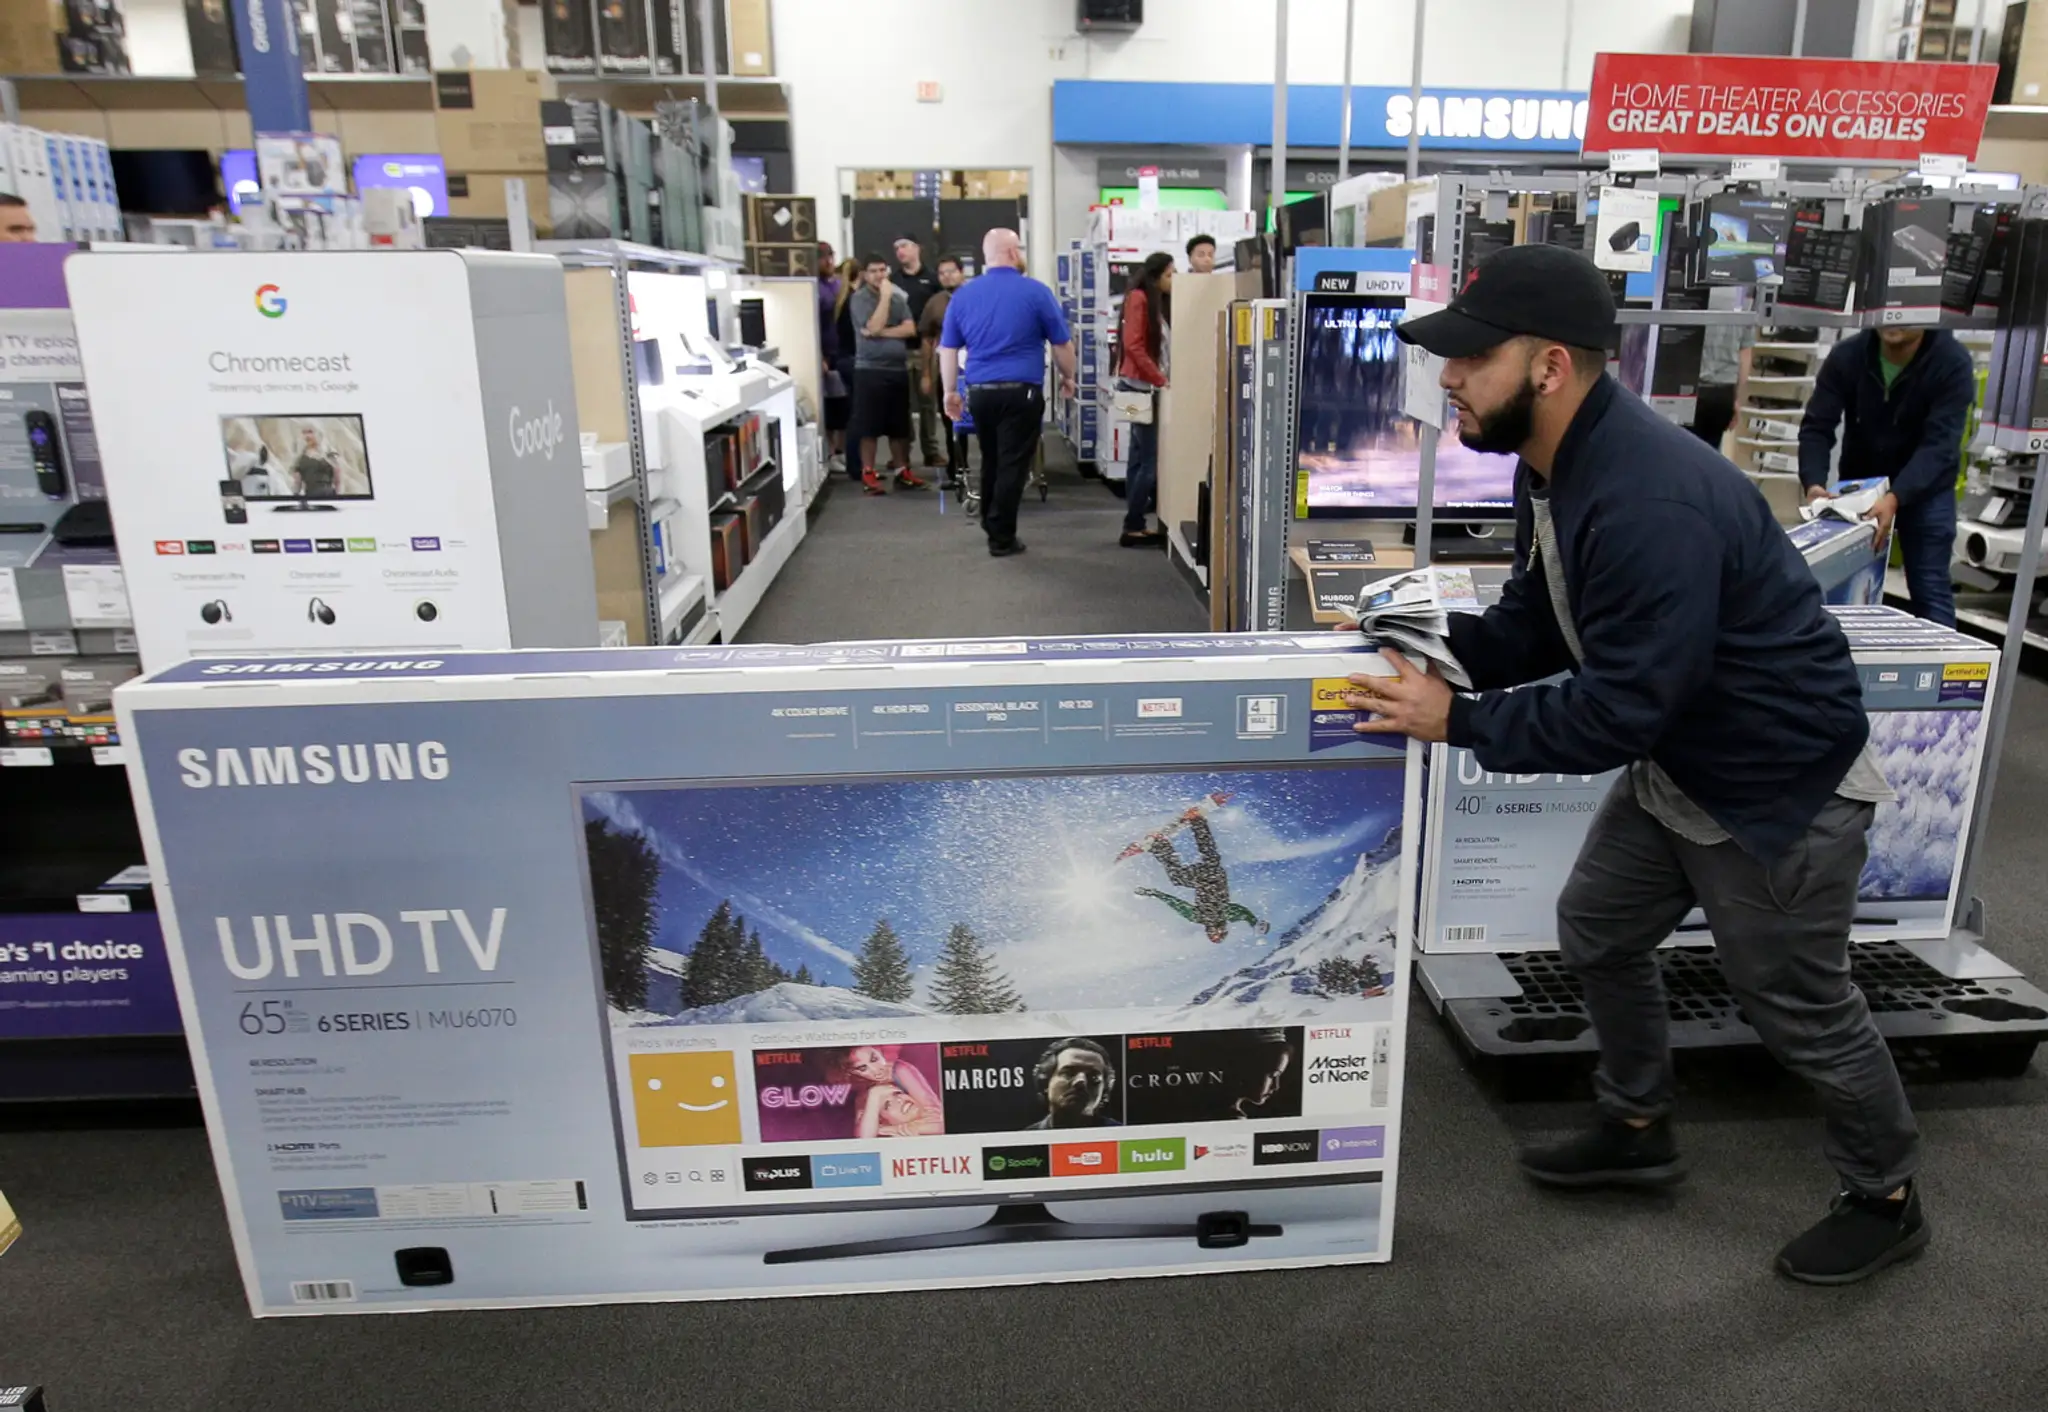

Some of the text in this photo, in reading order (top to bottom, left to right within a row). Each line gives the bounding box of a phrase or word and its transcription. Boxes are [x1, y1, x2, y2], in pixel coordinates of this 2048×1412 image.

[1612, 83, 1966, 118] HOME THEATER ACCESSORIES
[1607, 108, 1928, 142] GREAT DEALS ON CABLES
[1321, 278, 1349, 290] NEW
[1366, 280, 1404, 291] UHD TV
[1324, 319, 1357, 329] ULTRA
[208, 351, 352, 373] Chromecast
[320, 380, 359, 394] Google
[509, 400, 564, 460] Google
[201, 659, 445, 676] SAMSUNG
[1007, 701, 1039, 711] BLACK
[1142, 702, 1177, 713] NETFLIX
[986, 713, 1008, 722] PRO
[177, 741, 449, 788] SAMSUNG
[1504, 802, 1542, 814] SERIES
[1551, 801, 1597, 813] MU6300
[61, 940, 144, 960] choice
[216, 908, 507, 980] UHD TV
[0, 966, 128, 984] aming players
[333, 1012, 410, 1032] SERIES
[429, 1008, 517, 1030] MU6070
[752, 1029, 907, 1045] Continue Watching for Chris
[1310, 1028, 1352, 1040] NETFLIX
[664, 1036, 717, 1050] Watching
[1128, 1036, 1172, 1049] NETFLIX
[756, 1053, 802, 1065] NETFLIX
[943, 1045, 989, 1058] NETFLIX
[1307, 1055, 1367, 1070] Master
[944, 1066, 1025, 1091] NARCOS
[1129, 1070, 1224, 1089] CROWN
[1308, 1069, 1370, 1084] of None
[760, 1083, 852, 1107] GLOW
[1284, 1142, 1312, 1152] NOW
[1007, 1157, 1043, 1168] Spotify
[1131, 1148, 1174, 1163] hulu
[859, 1165, 872, 1173] TV
[892, 1155, 972, 1178] NETFLIX
